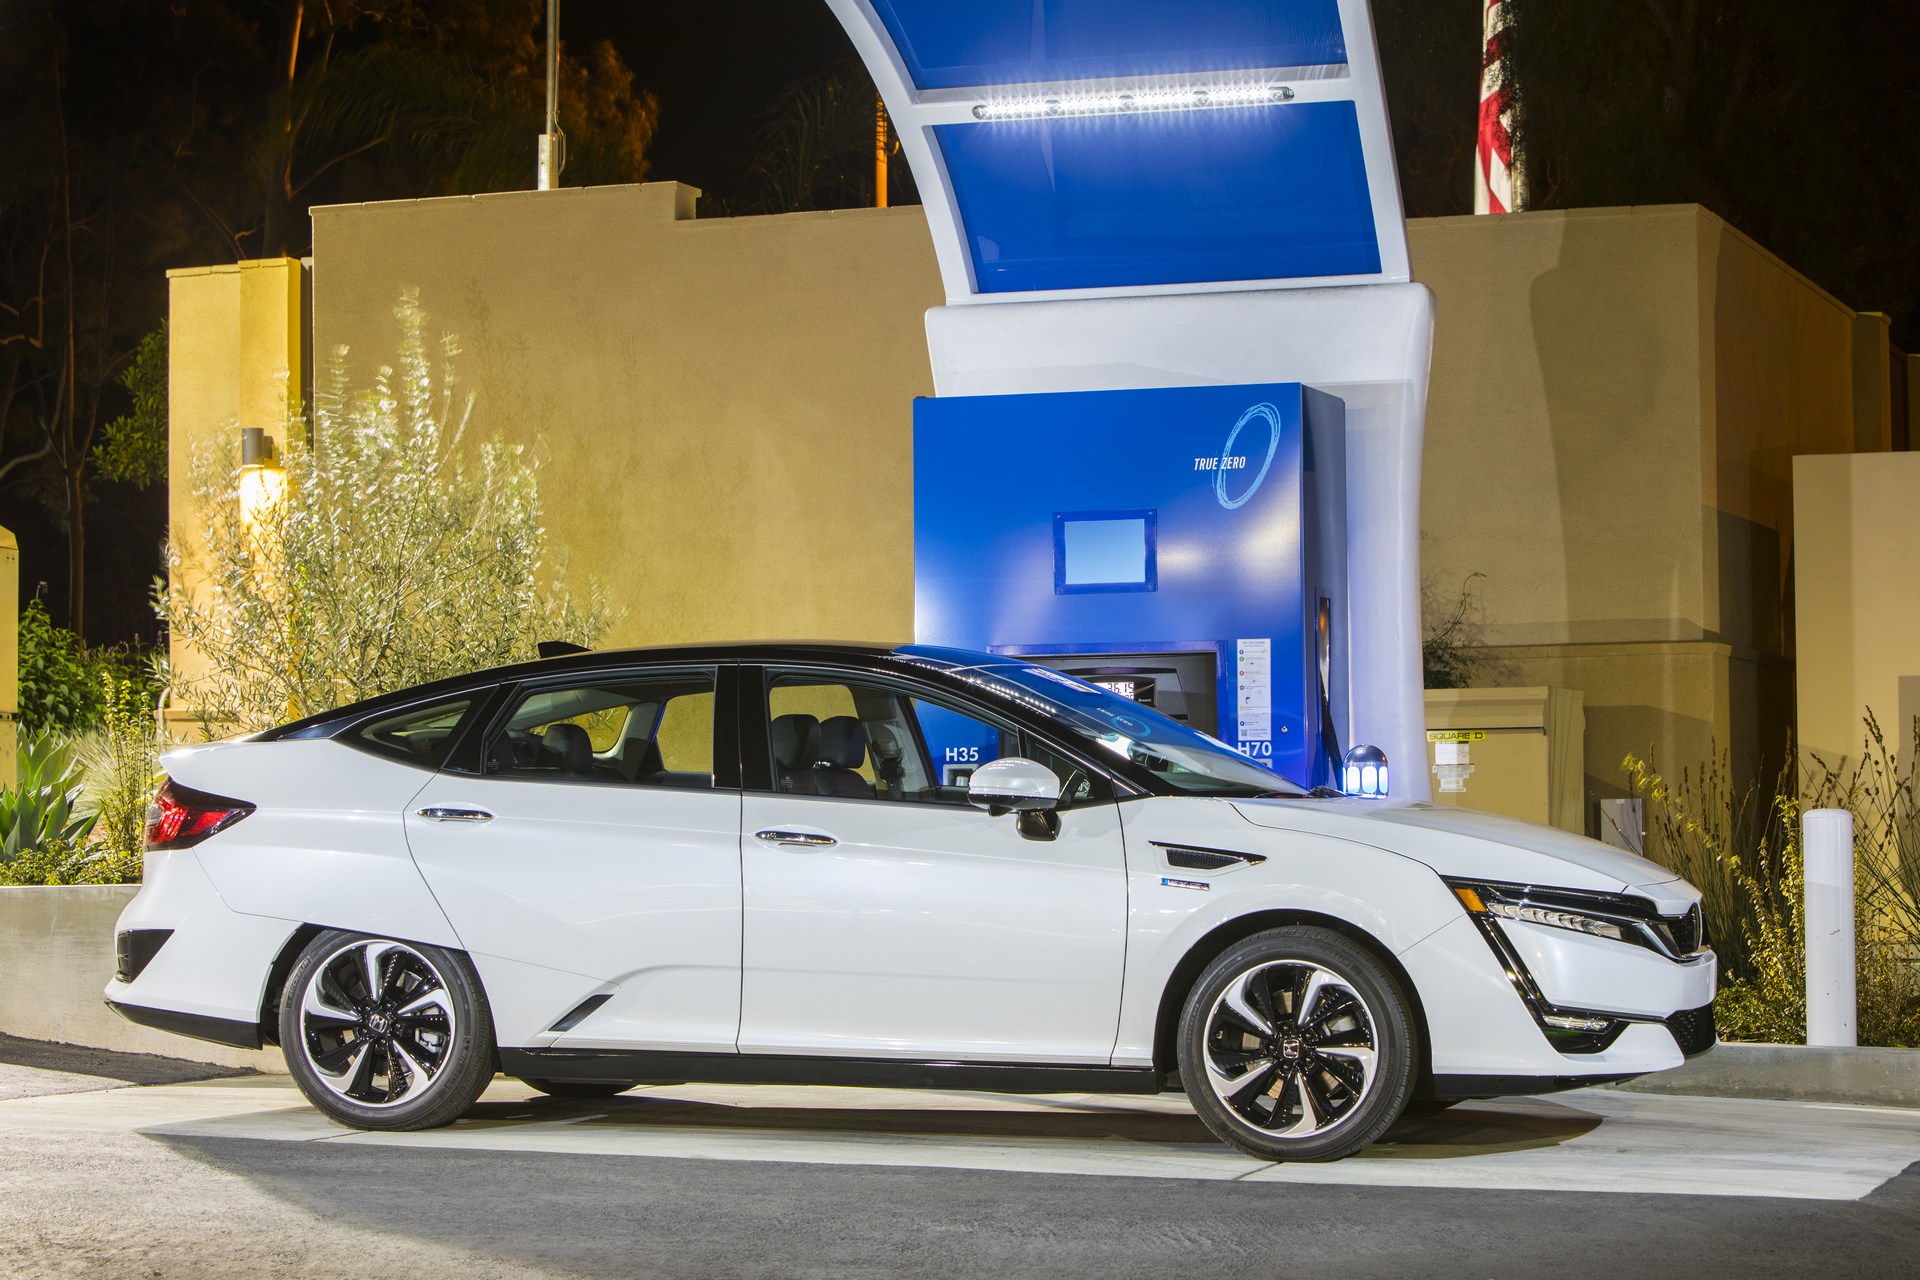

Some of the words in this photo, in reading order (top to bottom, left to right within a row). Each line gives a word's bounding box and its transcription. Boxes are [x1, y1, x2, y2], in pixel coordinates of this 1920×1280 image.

[1194, 457, 1219, 471] TRUE
[1221, 456, 1246, 470] ZERO
[1429, 732, 1471, 740] SQUARE
[946, 747, 979, 761] H35
[1238, 742, 1272, 757] H70
